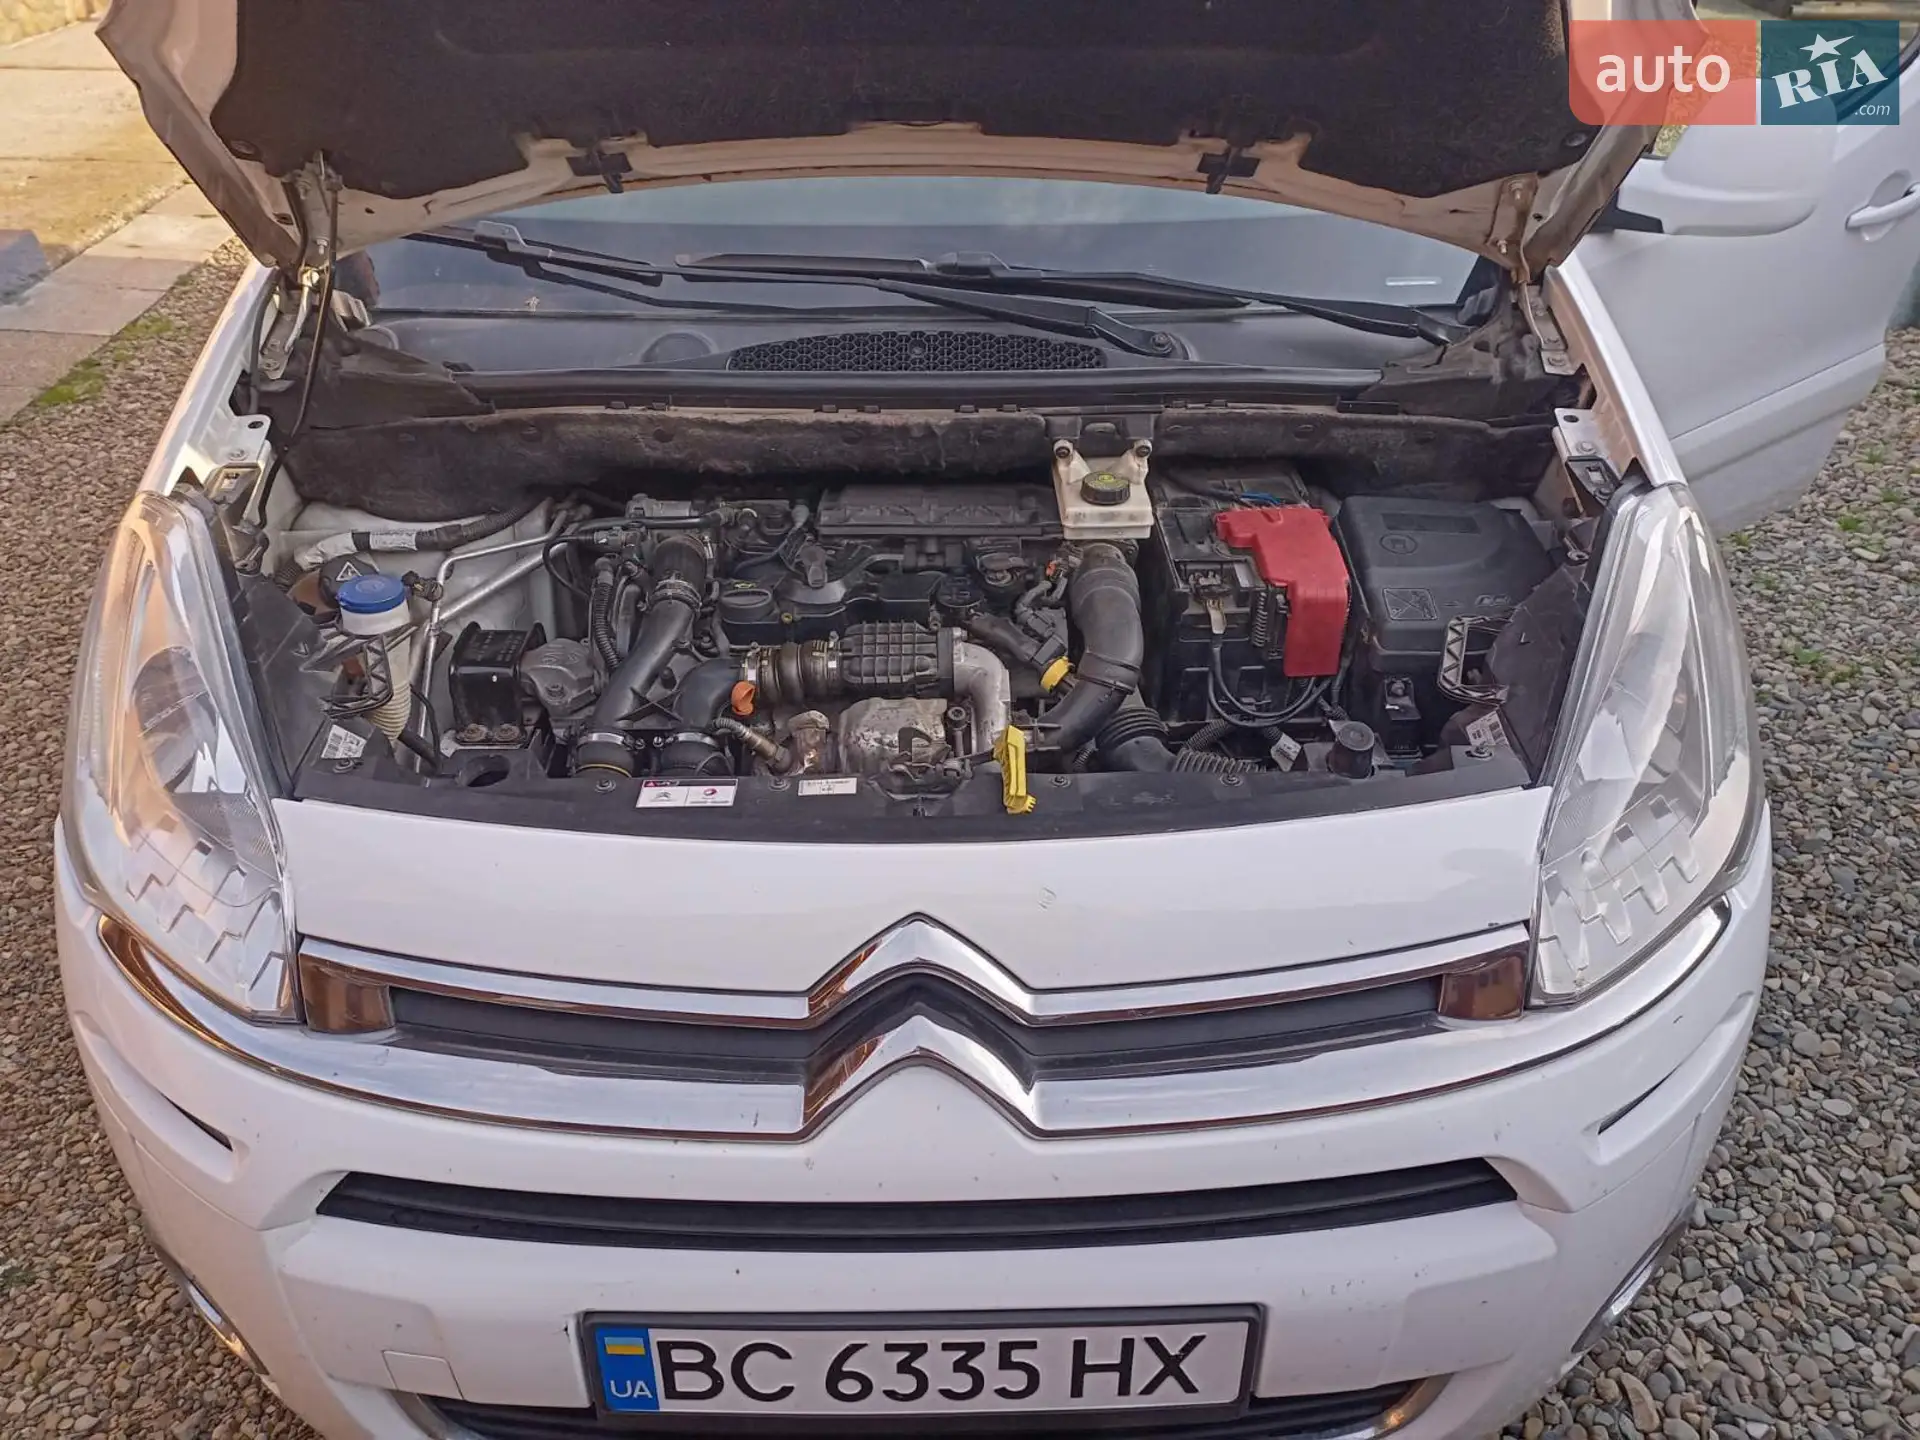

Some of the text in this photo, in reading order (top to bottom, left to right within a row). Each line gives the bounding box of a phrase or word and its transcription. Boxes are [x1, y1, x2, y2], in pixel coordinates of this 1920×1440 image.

[610, 1379, 653, 1399] UA
[657, 1334, 1208, 1402] BC 6335 HX
